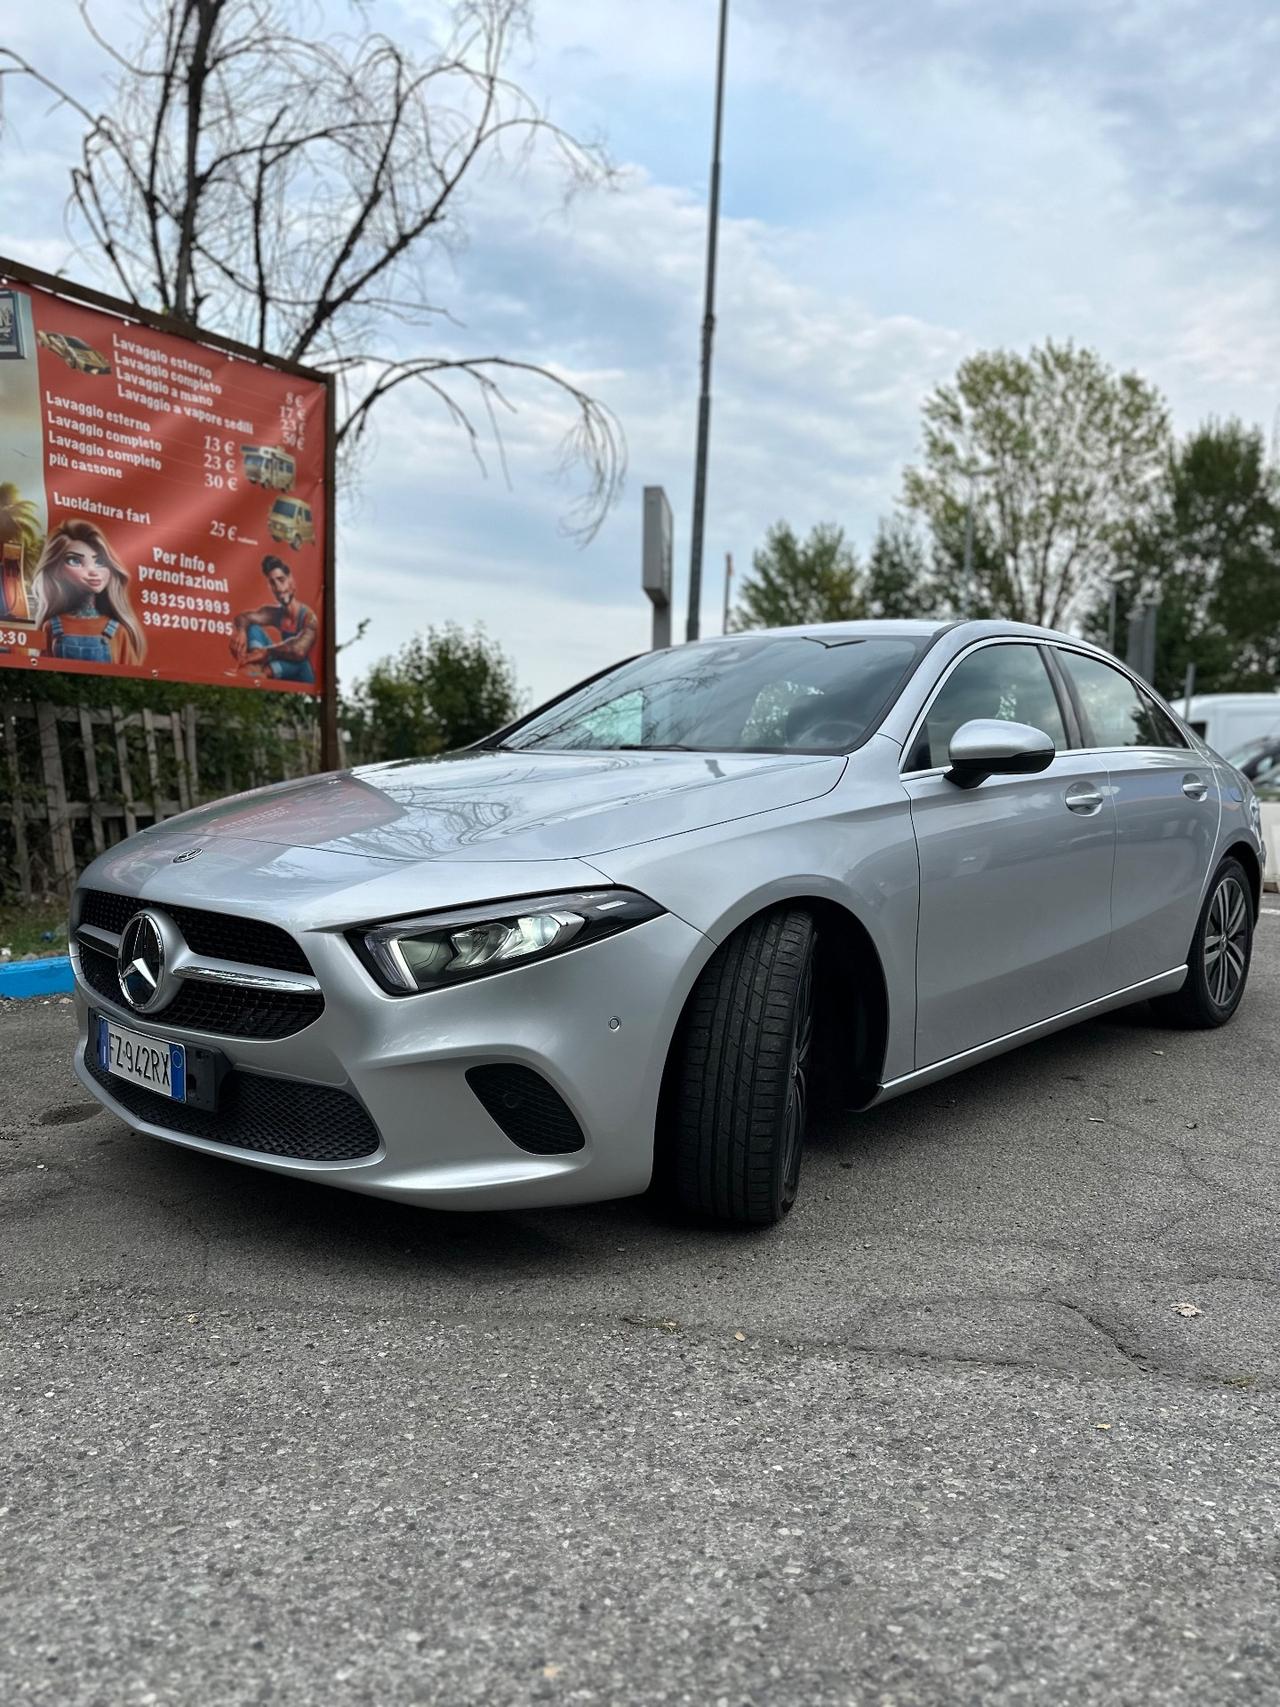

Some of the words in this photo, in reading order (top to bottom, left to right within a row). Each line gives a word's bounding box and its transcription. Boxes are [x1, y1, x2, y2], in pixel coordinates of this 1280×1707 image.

[113, 333, 168, 364] Lavaggio
[170, 356, 212, 380] esterno
[114, 350, 169, 379] Lavaggio
[170, 371, 222, 395] completo
[116, 367, 169, 395] Lavaggio
[171, 388, 179, 398] a
[180, 390, 213, 407] mano
[46, 390, 103, 419] Lavaggio
[106, 411, 151, 433] esterno
[117, 383, 171, 412] Lavaggio
[173, 404, 182, 415] a
[183, 406, 222, 426] vapore
[224, 418, 254, 435] sedili
[280, 405, 293, 419] 17
[48, 410, 103, 438] Lavaggio
[105, 430, 162, 453] completo
[204, 435, 221, 452] 13
[224, 441, 235, 456] €
[49, 429, 104, 458] Lavaggio
[107, 449, 162, 471] completo
[203, 453, 221, 470] 23
[225, 458, 236, 474] €
[50, 453, 68, 468] più
[71, 460, 123, 479] cassone
[204, 473, 223, 490] 30
[228, 476, 238, 492] €
[54, 491, 123, 520] Lucidatura
[126, 508, 151, 524] fari
[209, 520, 226, 537] 25
[227, 526, 237, 541] €
[152, 547, 179, 566] Per
[180, 553, 205, 571] info
[207, 563, 216, 574] e
[138, 565, 229, 593] prenotazioni
